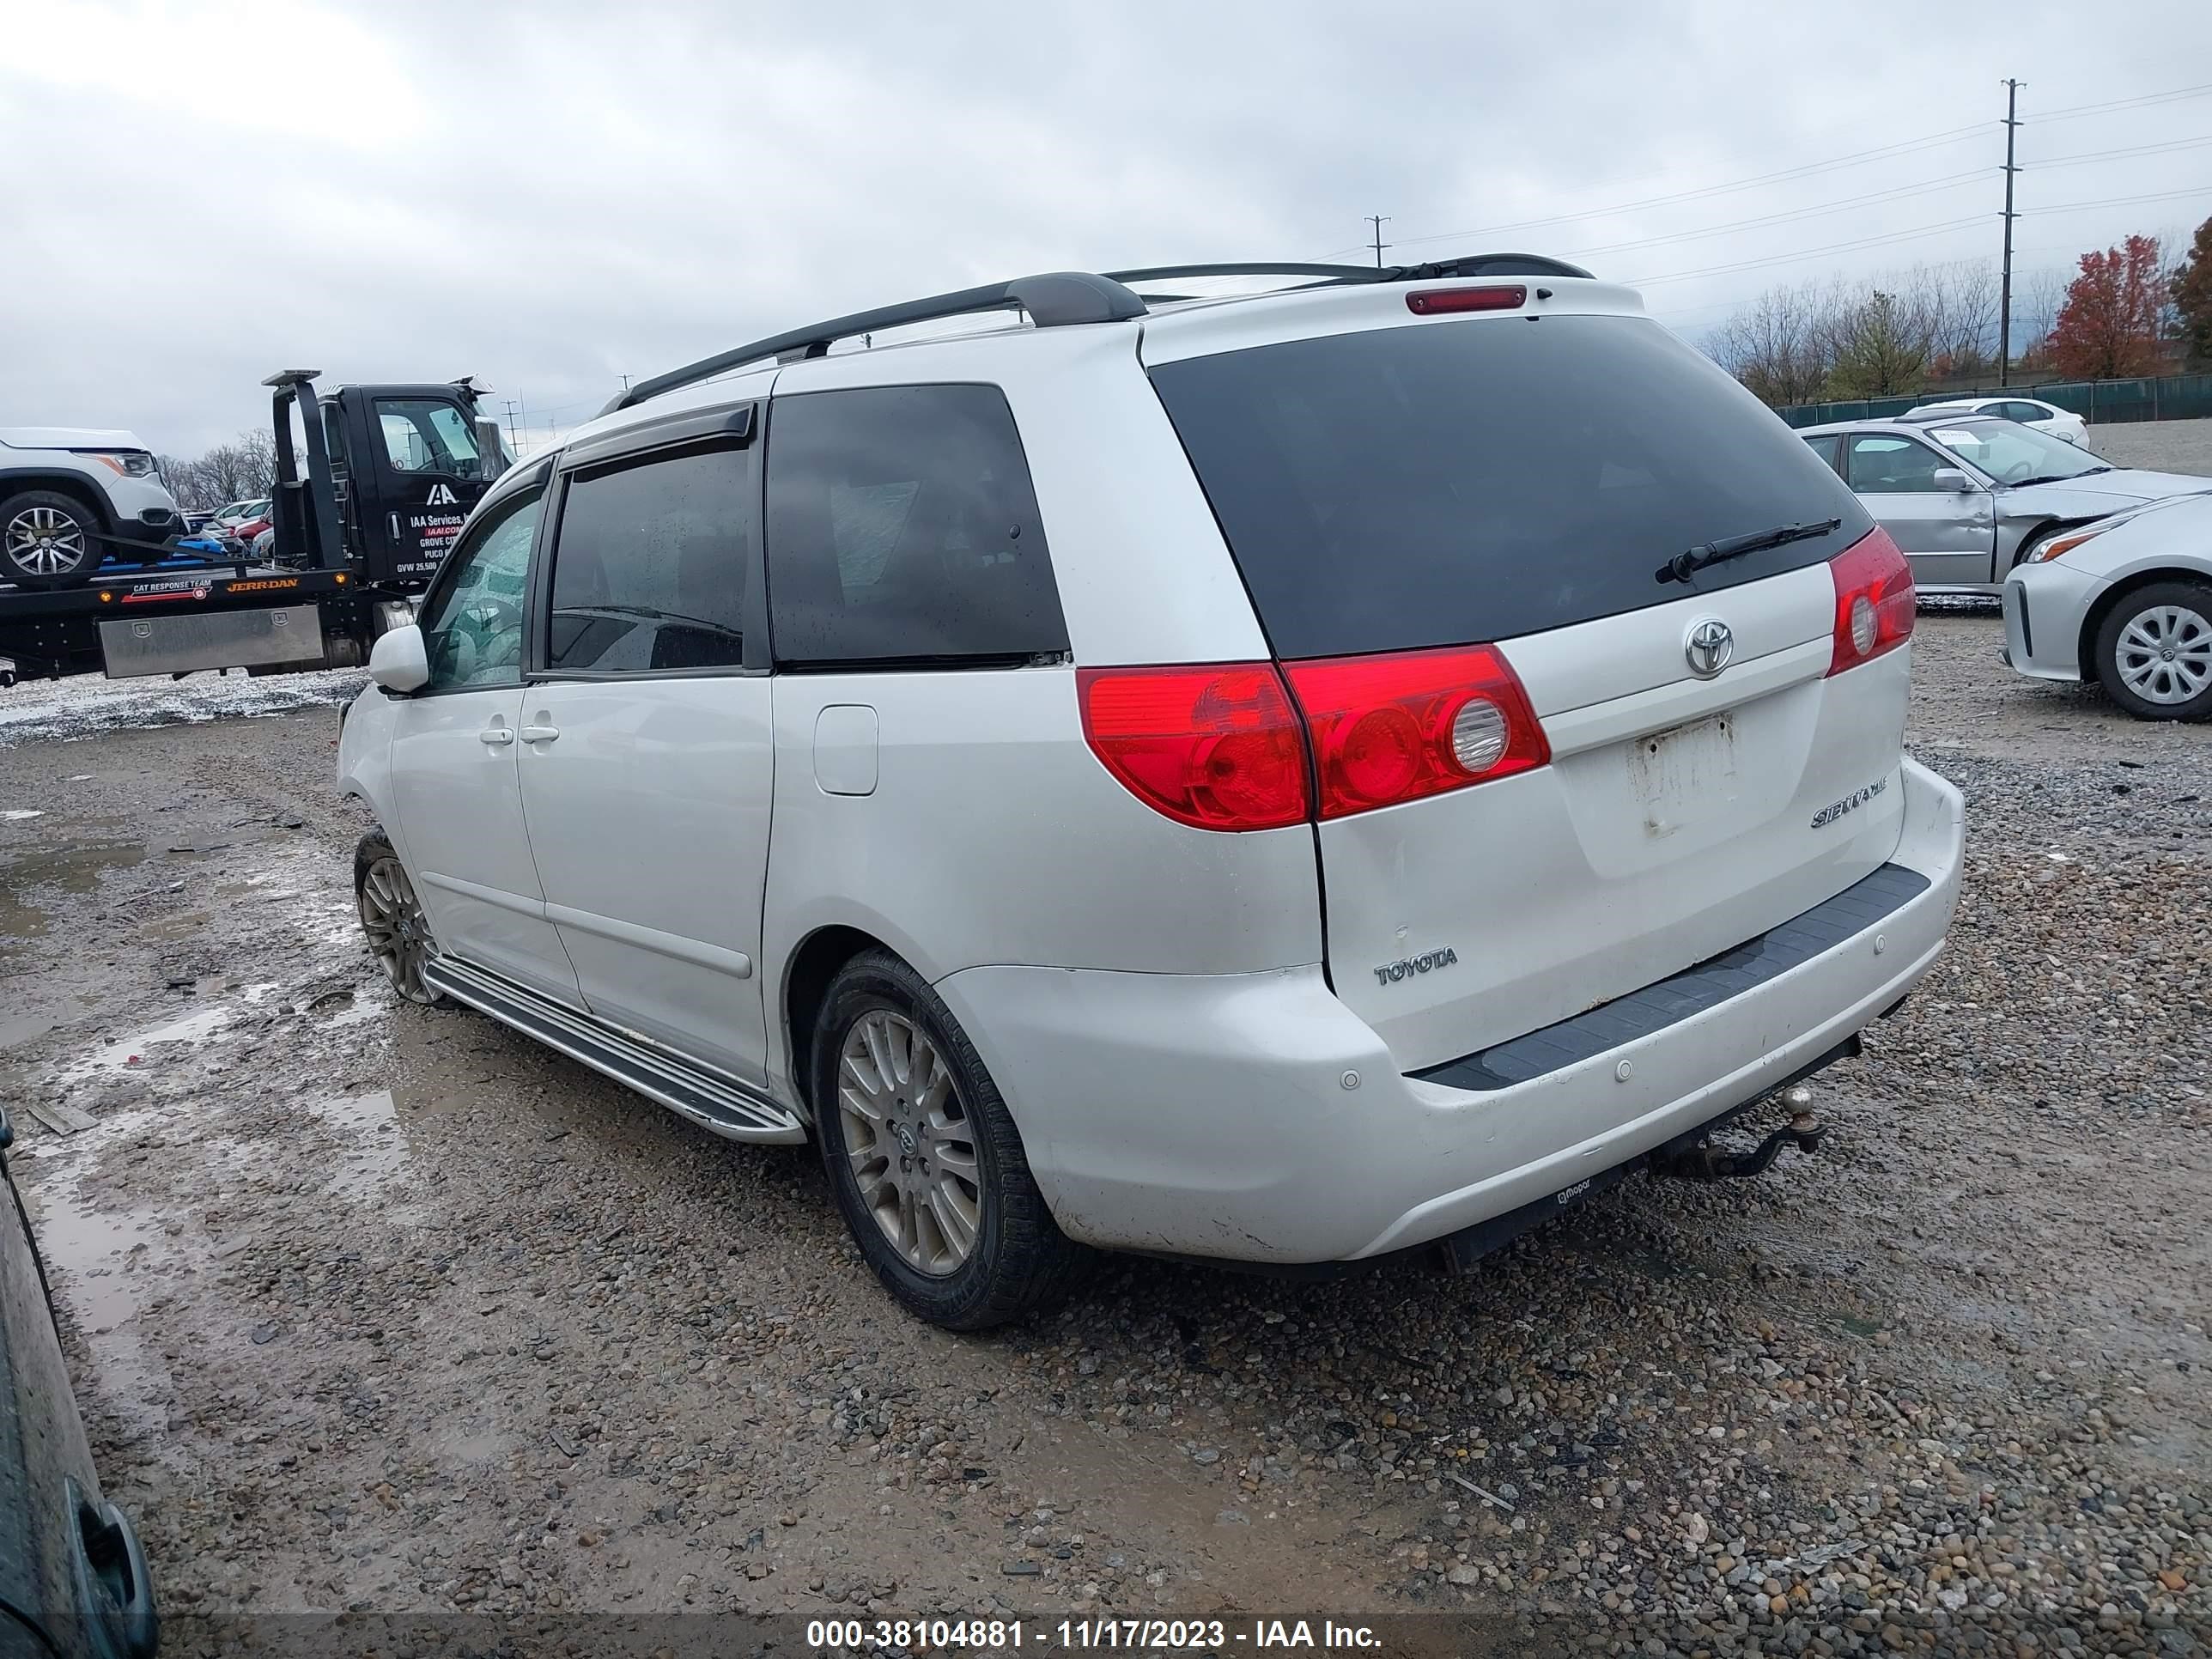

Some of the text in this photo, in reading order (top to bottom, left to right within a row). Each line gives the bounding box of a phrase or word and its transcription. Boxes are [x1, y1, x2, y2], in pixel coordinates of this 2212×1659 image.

[410, 516, 427, 528] IAA
[420, 537, 445, 548] GROVE
[424, 549, 444, 559] PUCO
[397, 563, 415, 573] GVW
[150, 581, 190, 592] RESPONSE
[190, 579, 212, 588] TEAM
[1374, 945, 1458, 986] TOYOTA
